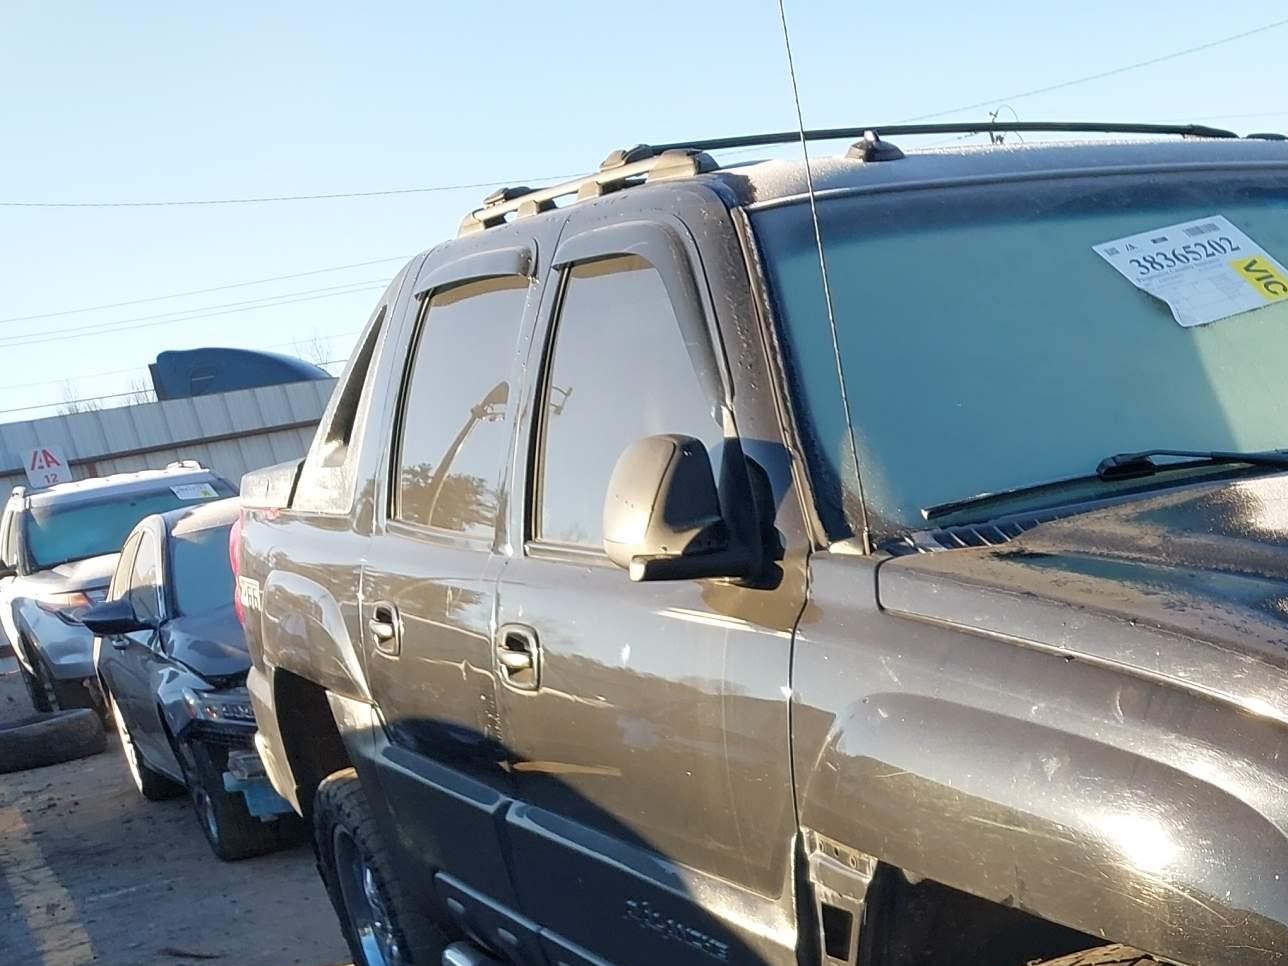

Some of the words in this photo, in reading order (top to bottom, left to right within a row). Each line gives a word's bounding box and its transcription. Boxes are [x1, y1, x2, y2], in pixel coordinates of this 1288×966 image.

[1129, 236, 1241, 275] 38365202
[1243, 258, 1288, 295] VIC
[44, 473, 59, 484] 12
